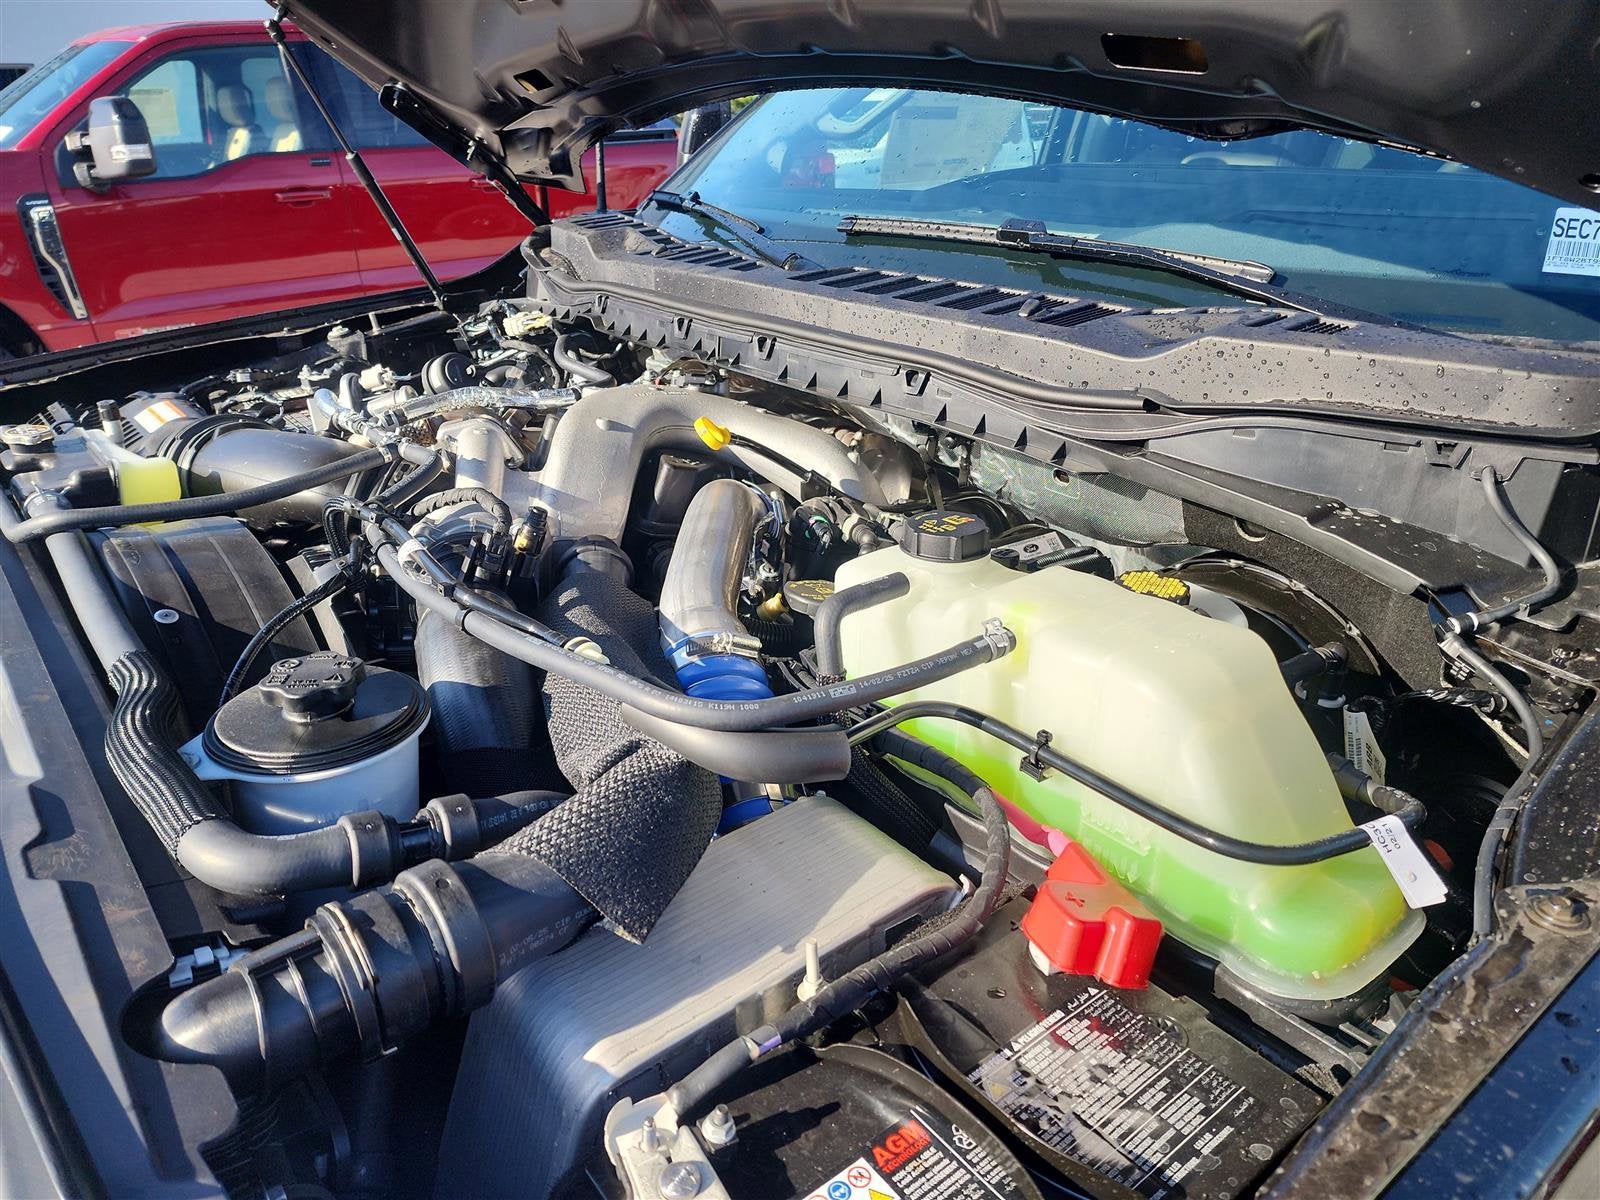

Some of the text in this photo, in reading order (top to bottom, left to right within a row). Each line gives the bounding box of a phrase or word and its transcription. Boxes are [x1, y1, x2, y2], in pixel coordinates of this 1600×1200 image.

[872, 1119, 928, 1168] AGM
[882, 1135, 932, 1174] TECHNOLOGY
[891, 1146, 938, 1184] NON-SPILLABLE
[897, 1174, 914, 1189] Lead
